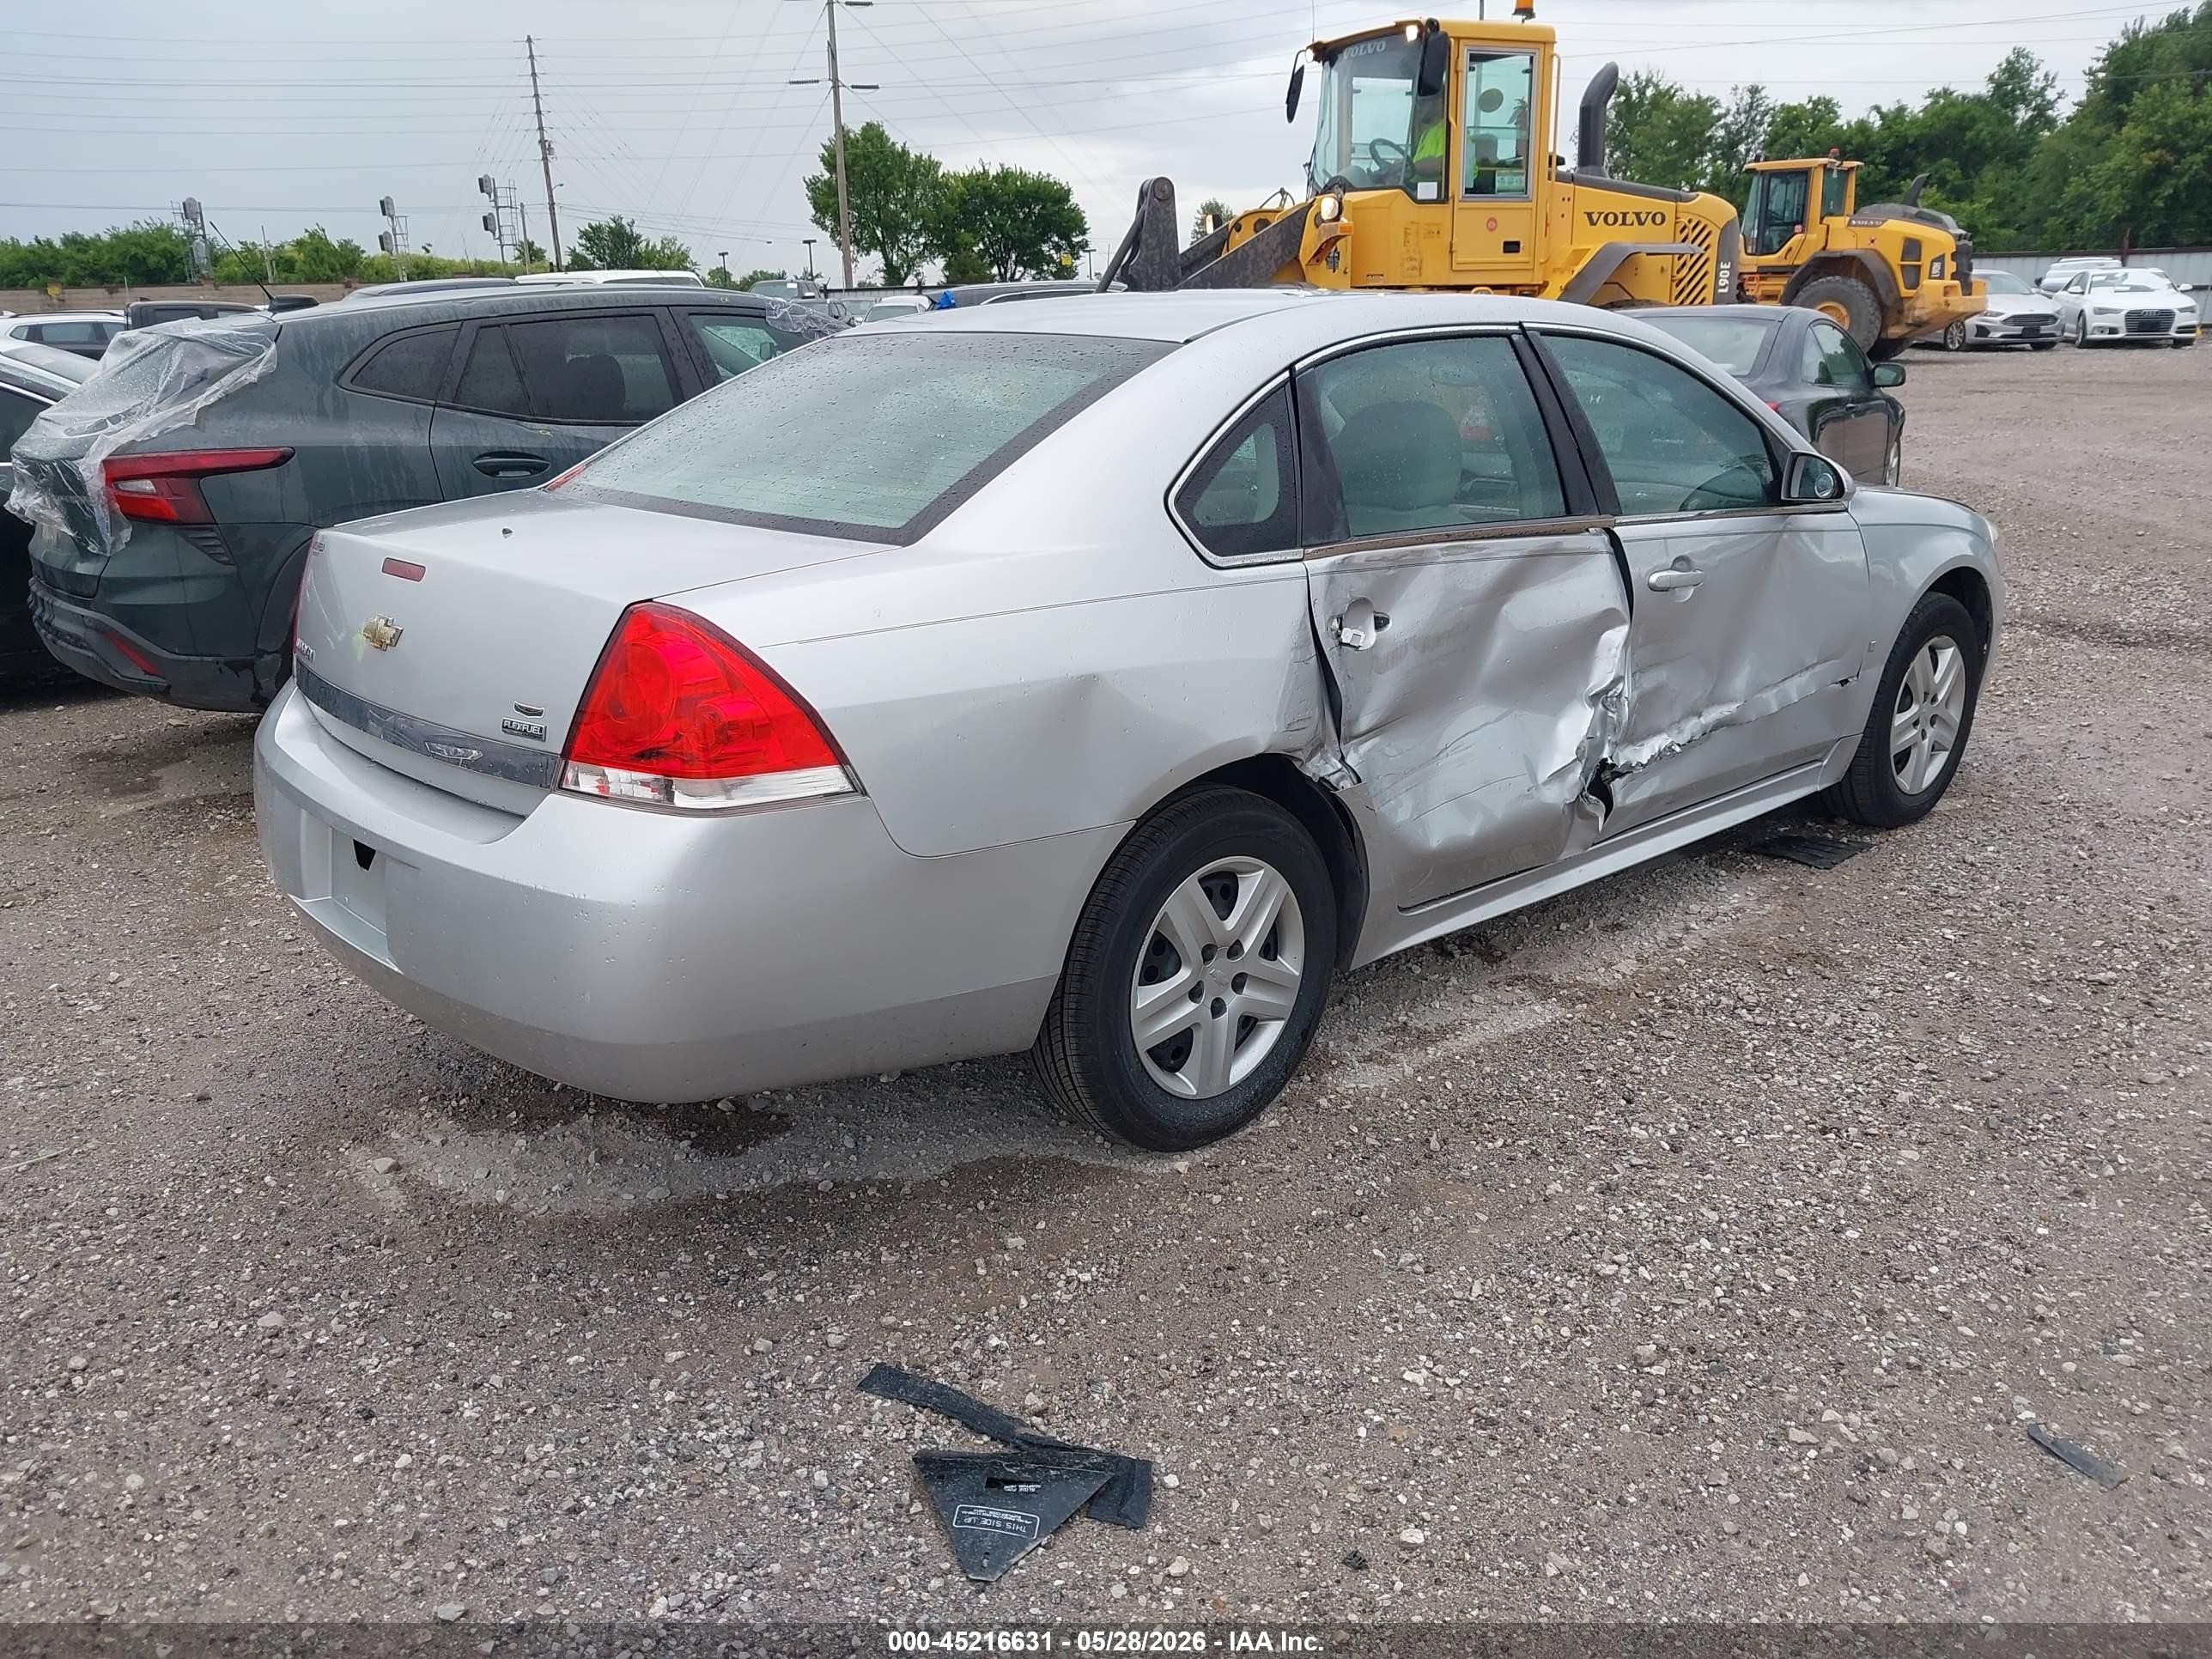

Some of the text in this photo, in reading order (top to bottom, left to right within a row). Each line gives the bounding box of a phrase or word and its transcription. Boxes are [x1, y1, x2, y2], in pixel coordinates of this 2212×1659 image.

[1343, 40, 1387, 59] VOLVO
[1583, 211, 1668, 228] VOLVO
[1717, 261, 1732, 294] L90E
[981, 1517, 1002, 1528] SIDE
[1006, 1522, 1027, 1533] THIS
